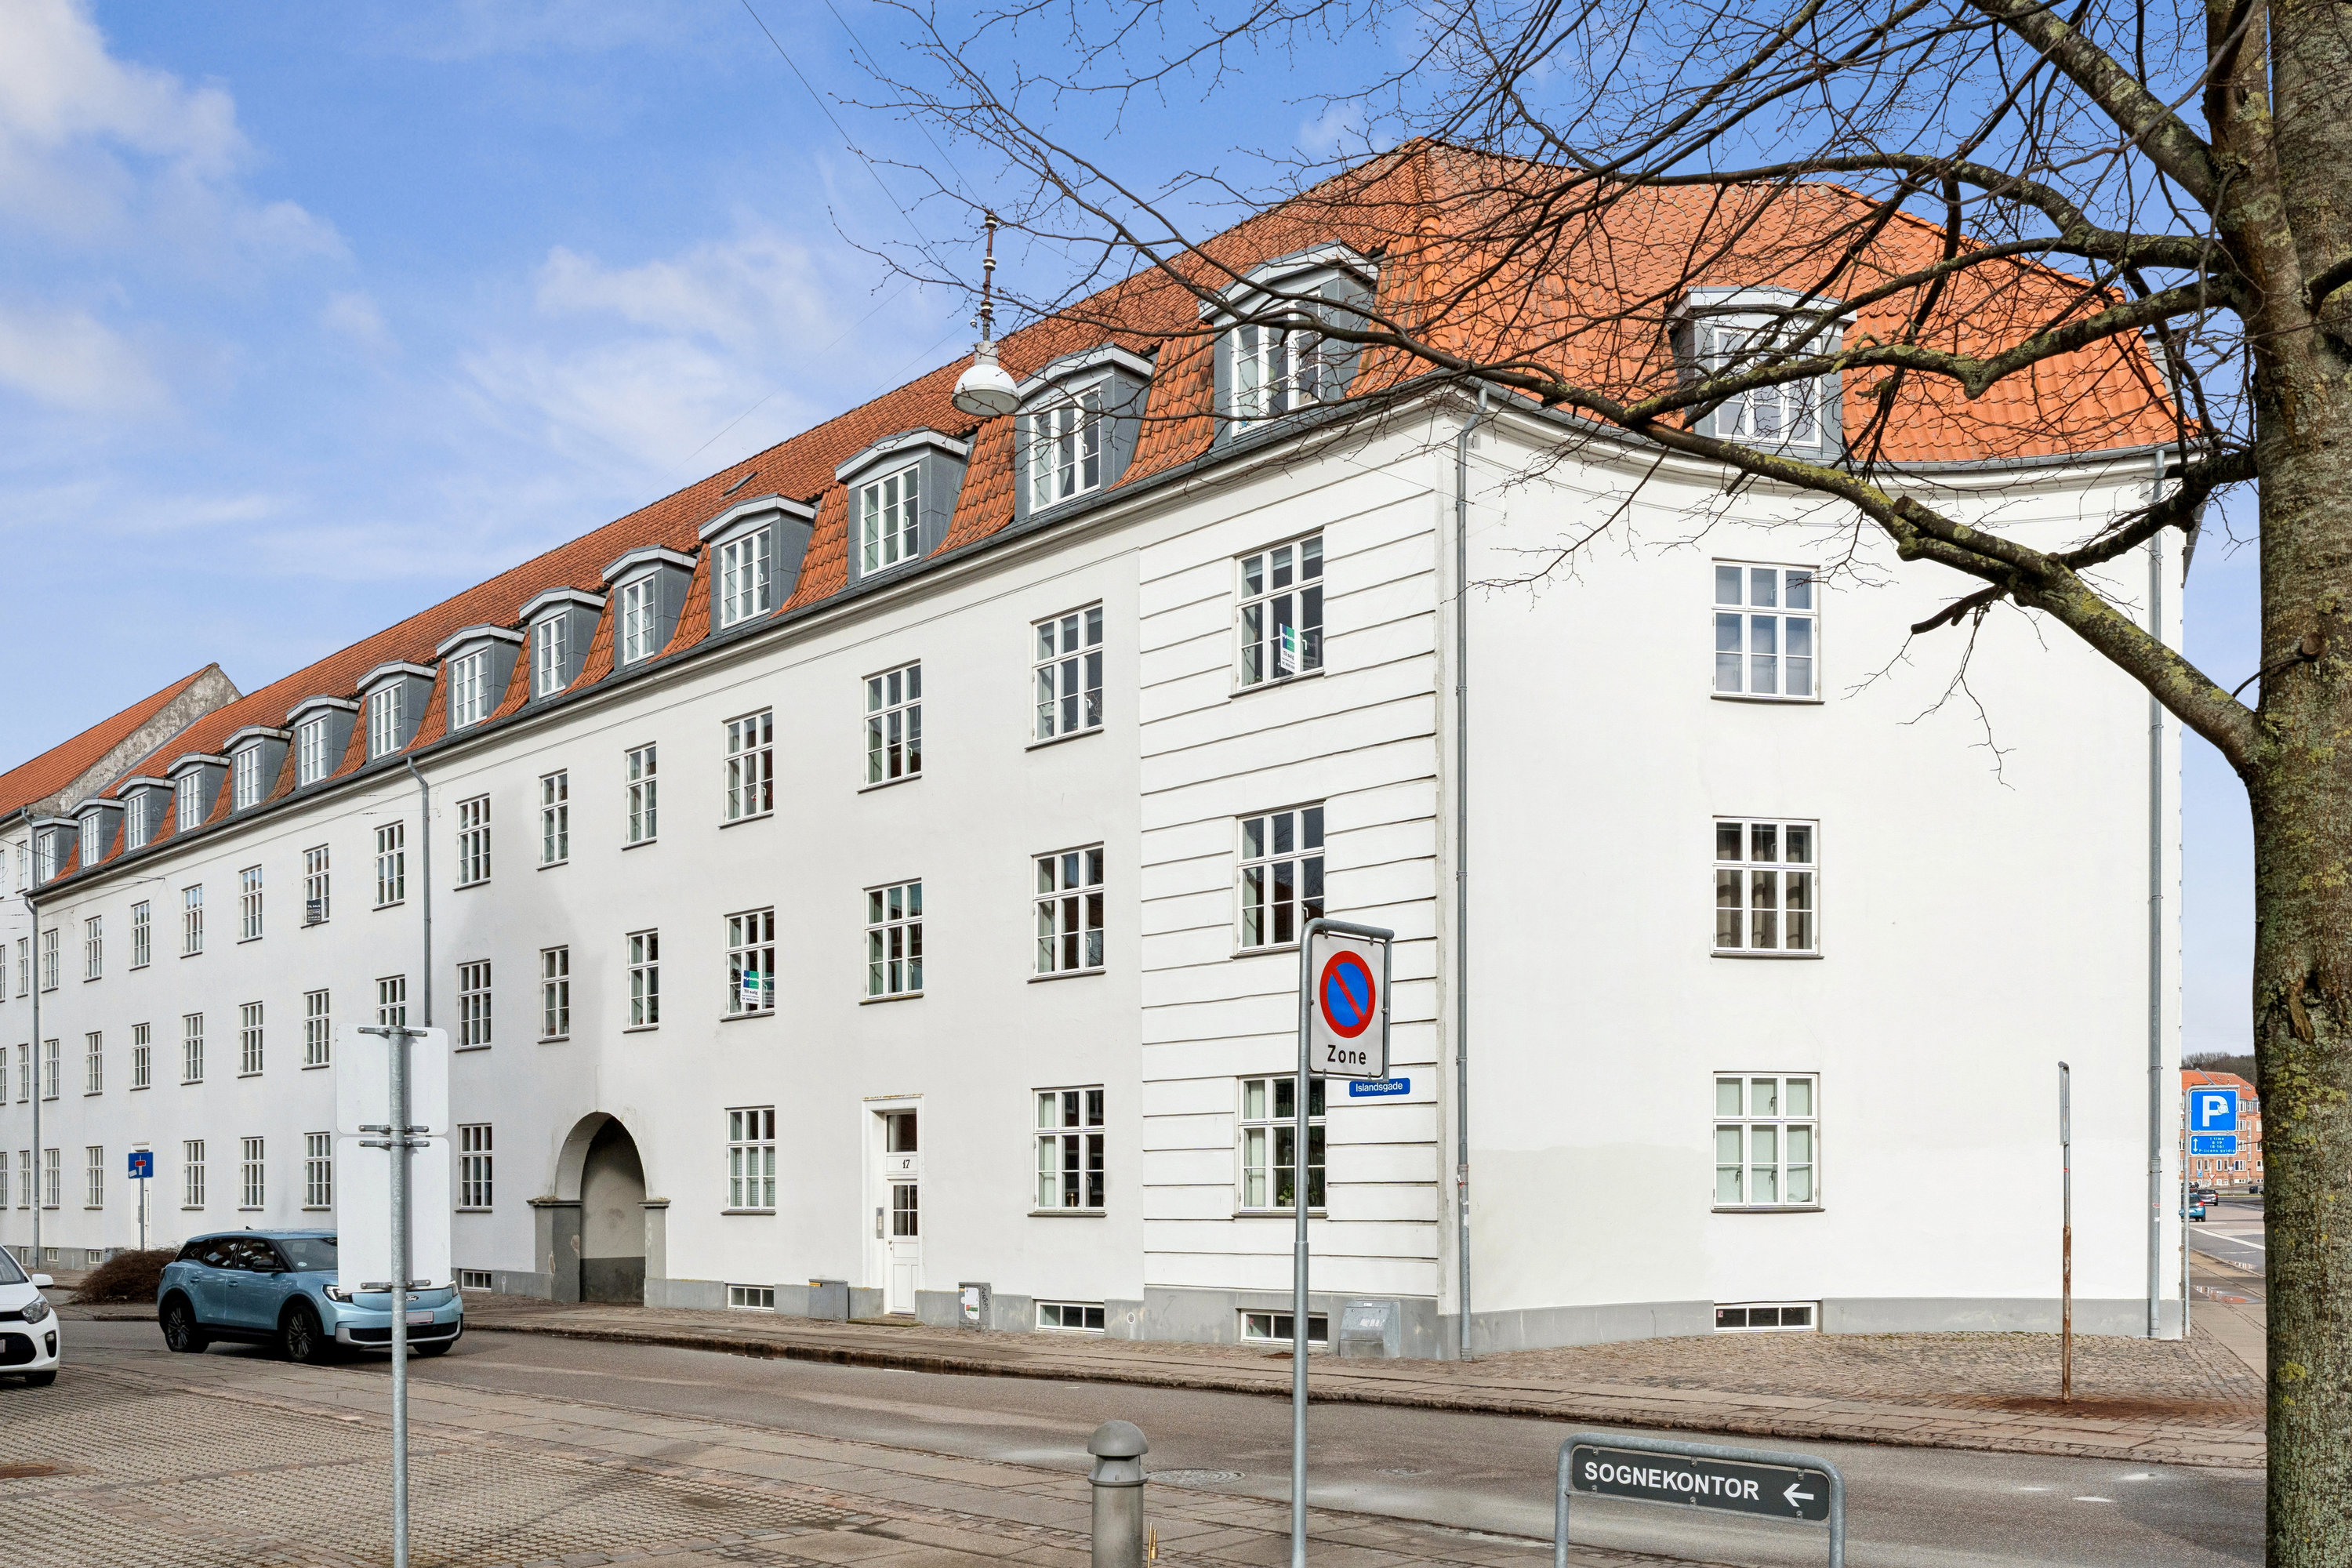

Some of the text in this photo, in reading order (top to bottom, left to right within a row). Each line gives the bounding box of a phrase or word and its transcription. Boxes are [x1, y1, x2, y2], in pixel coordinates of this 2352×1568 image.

[1327, 1044, 1367, 1065] Zone
[1356, 1081, 1403, 1092] Islandsgade
[2202, 1095, 2229, 1127] P
[902, 1159, 910, 1169] 17
[1584, 1461, 1760, 1501] SOGNEKONTOR
